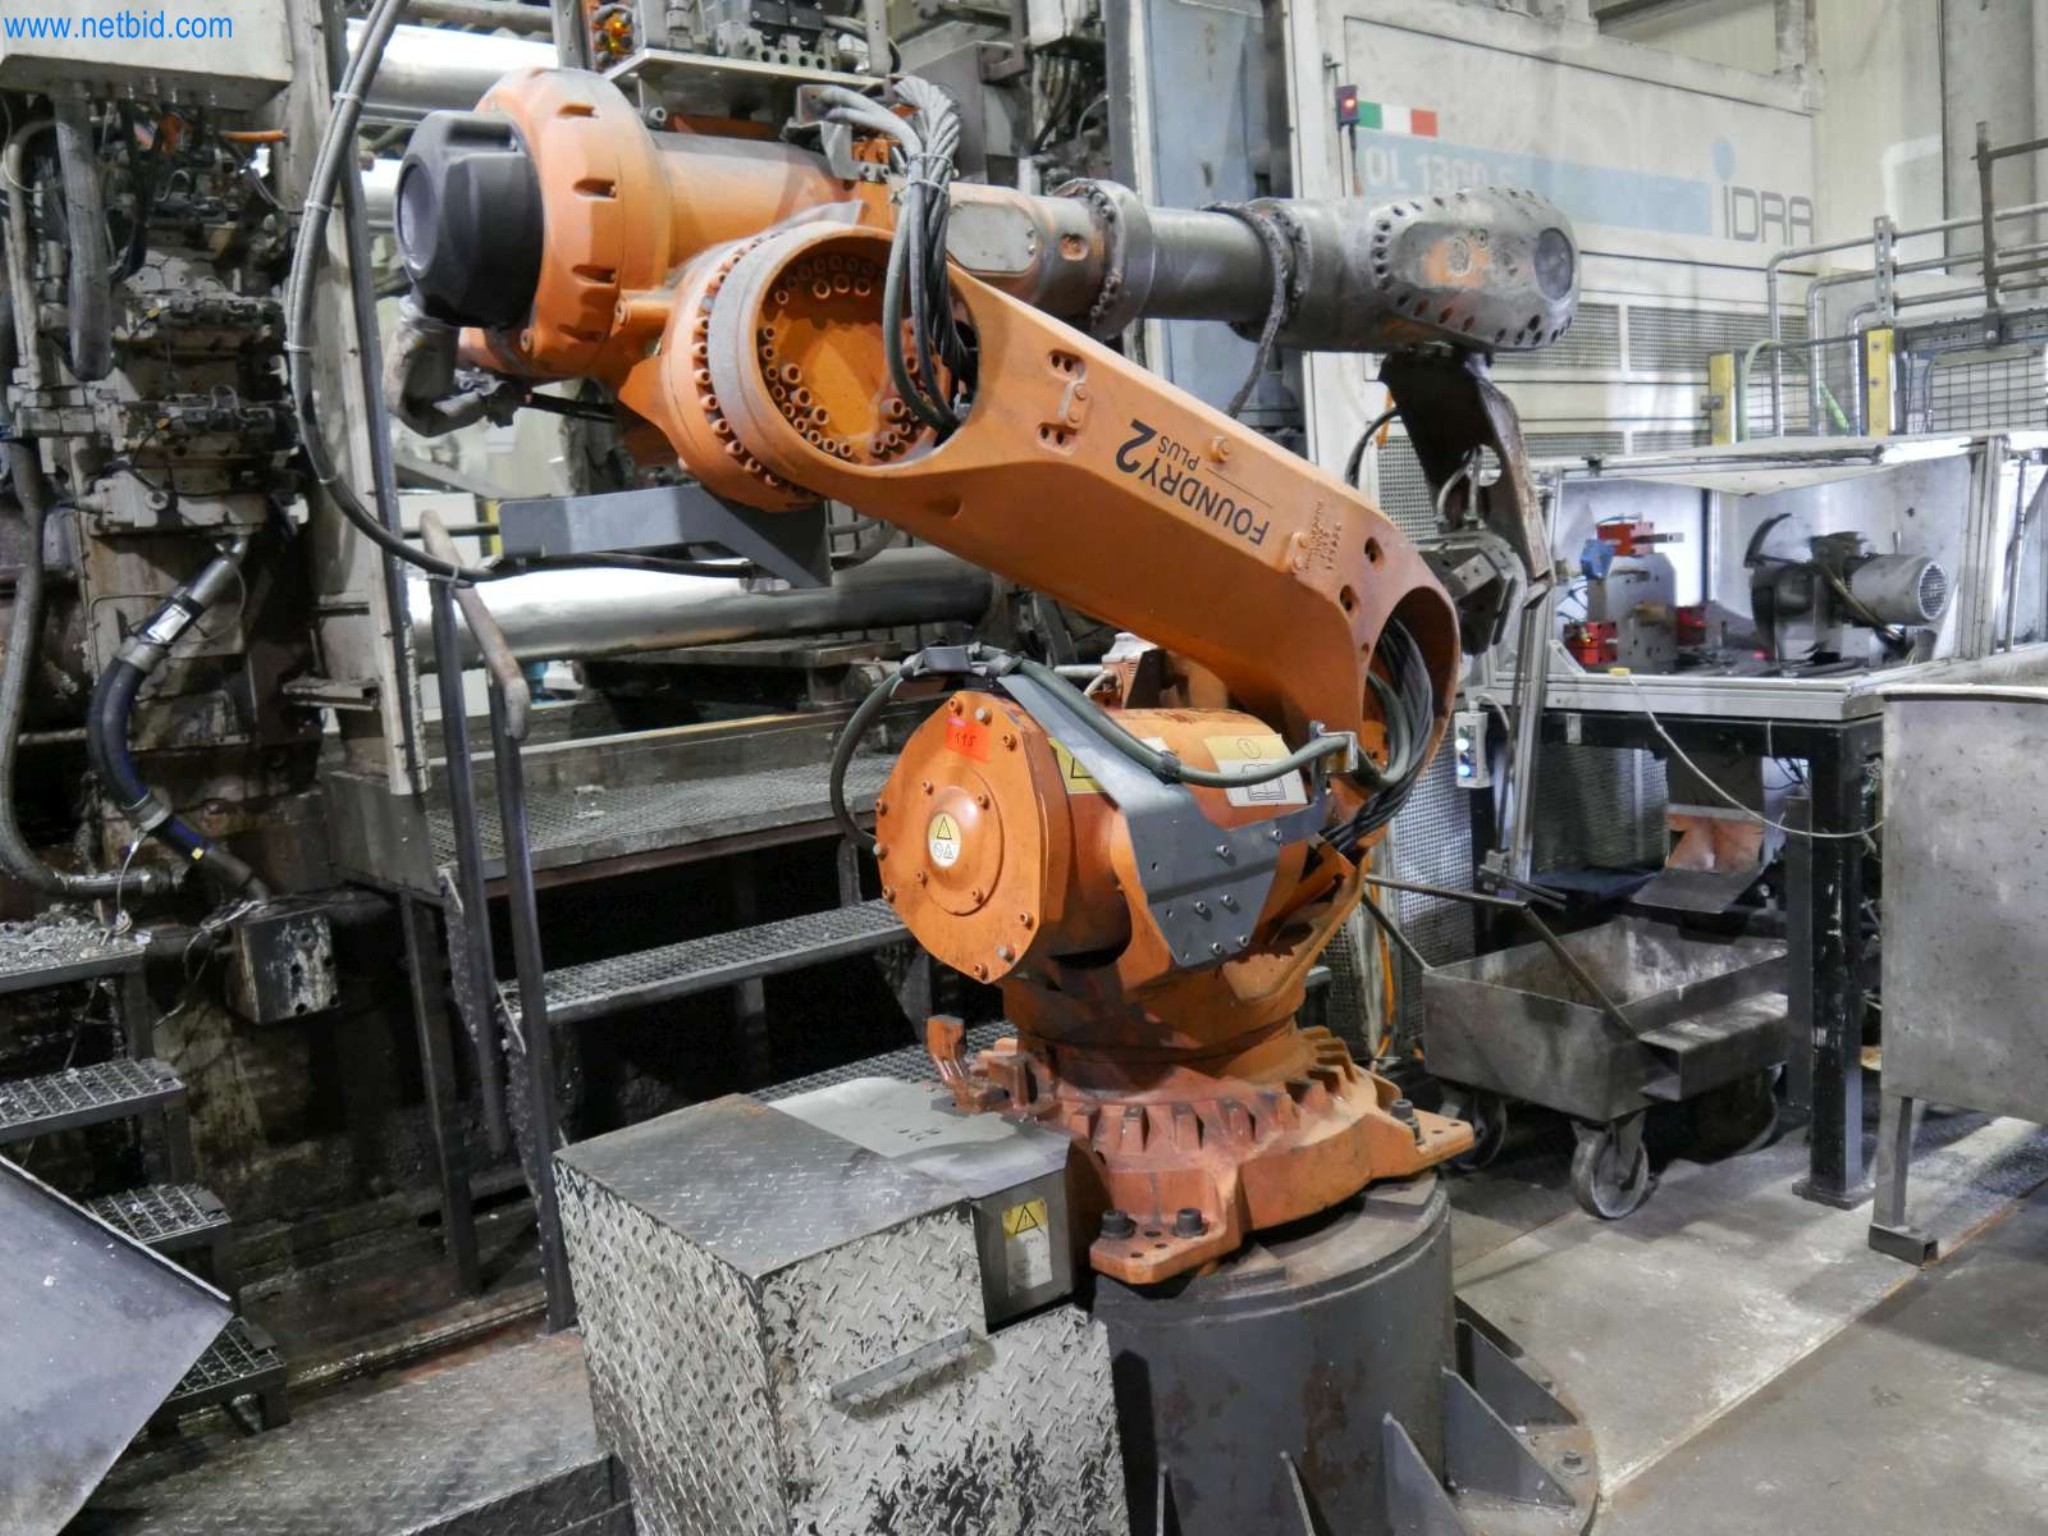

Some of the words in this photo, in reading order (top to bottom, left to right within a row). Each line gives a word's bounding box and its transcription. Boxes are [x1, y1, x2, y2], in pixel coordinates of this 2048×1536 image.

[1365, 145, 1408, 190] OL
[1723, 184, 1815, 246] IDRA
[1157, 435, 1200, 472] PLUS
[1138, 455, 1271, 546] FOUNDRY
